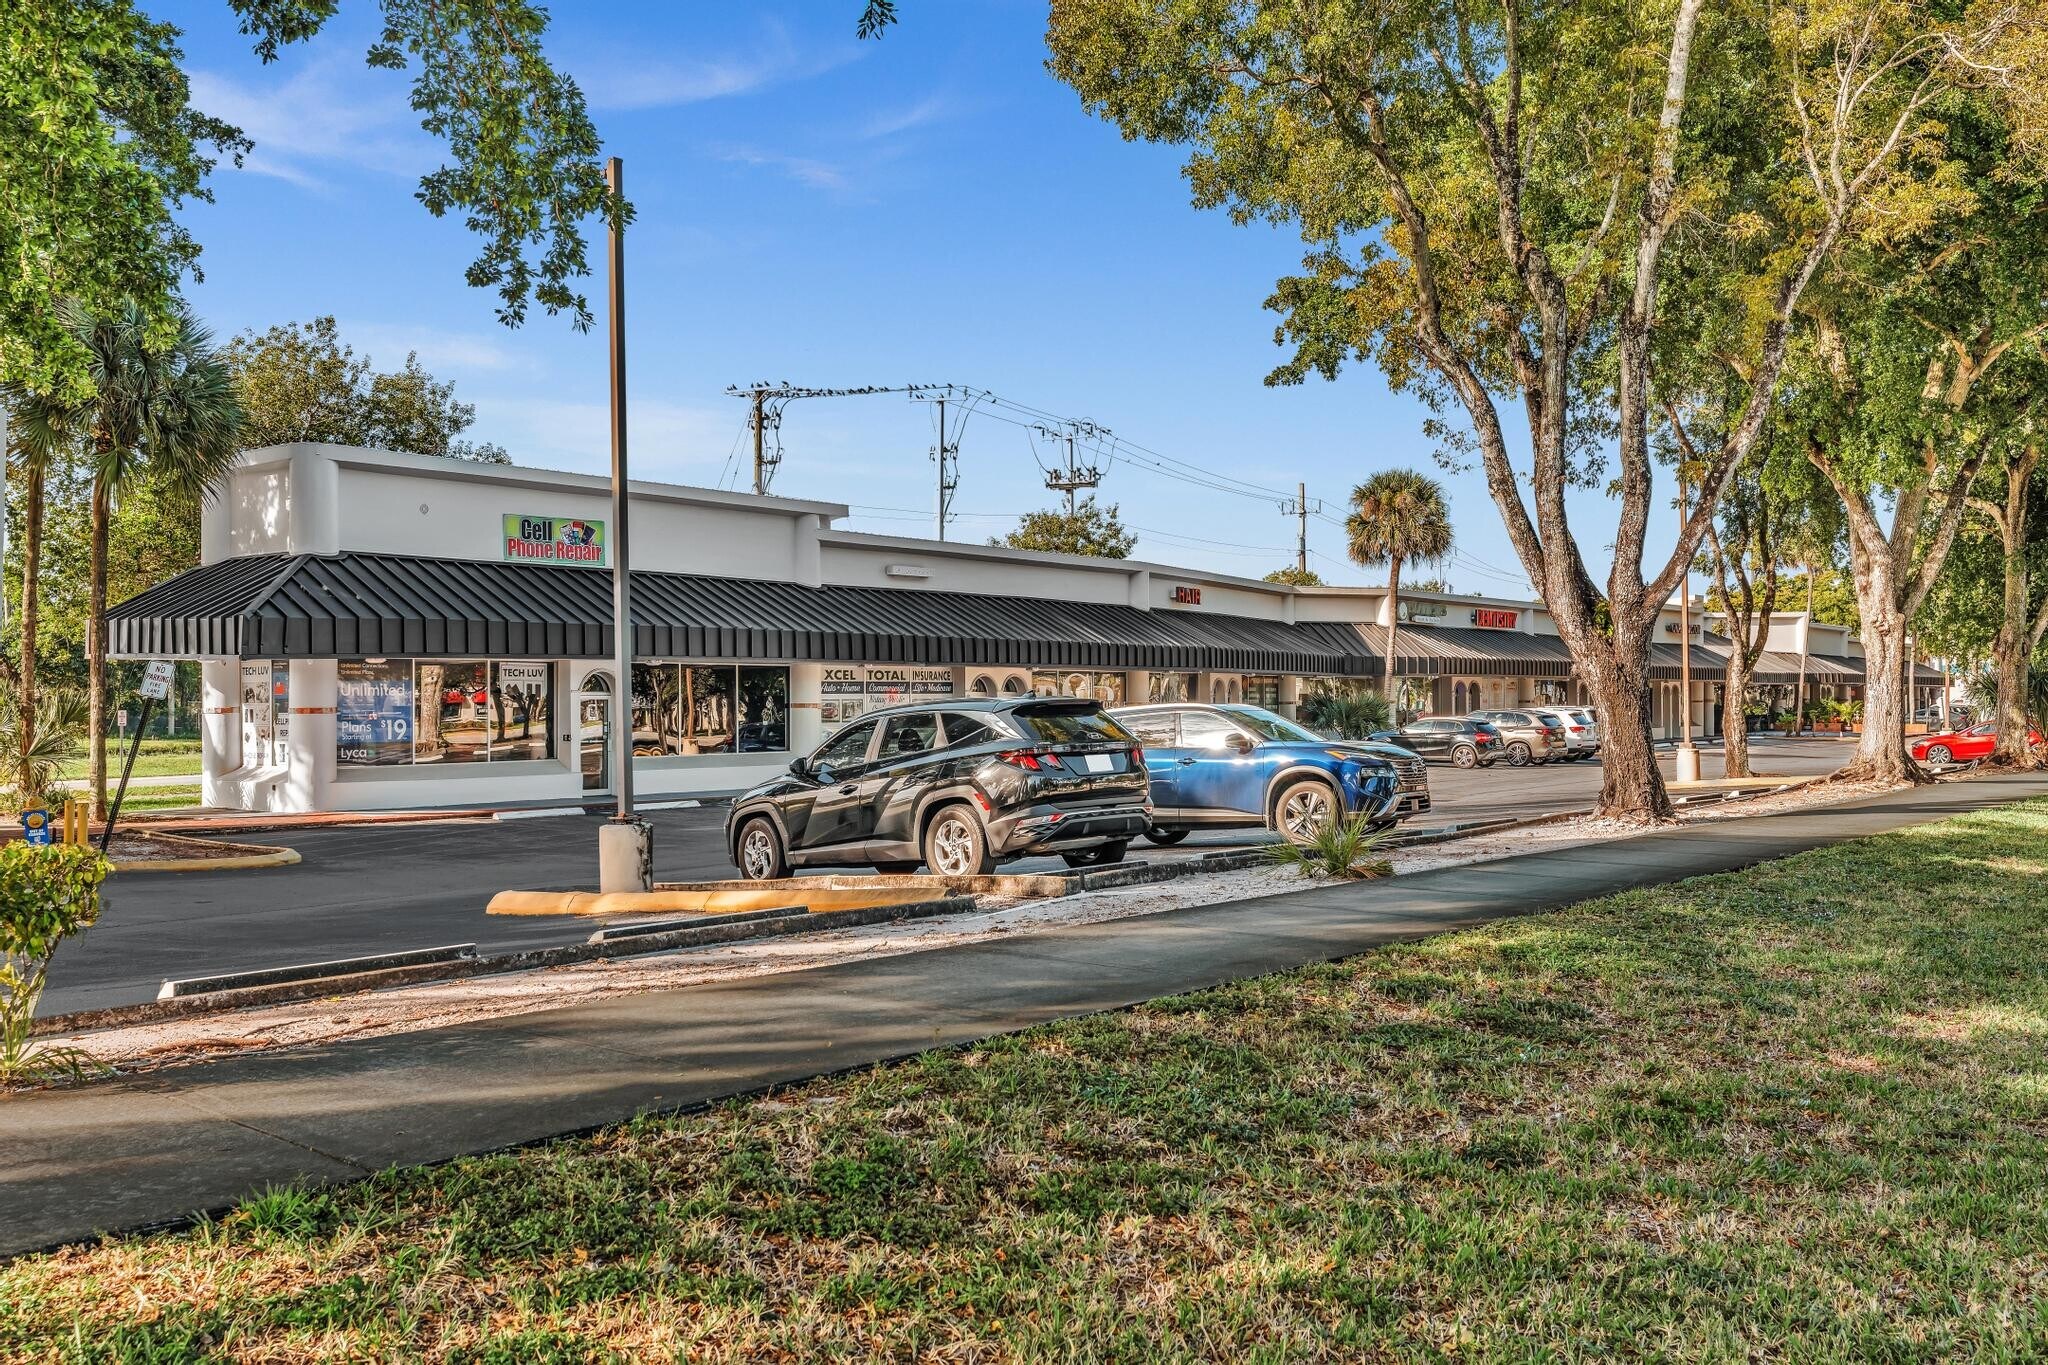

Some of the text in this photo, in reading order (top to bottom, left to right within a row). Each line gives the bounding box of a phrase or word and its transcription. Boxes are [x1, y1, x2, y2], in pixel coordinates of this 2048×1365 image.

[521, 518, 553, 541] Cell
[506, 538, 602, 561] Phone Repair
[1177, 587, 1201, 605] HAIR
[1476, 609, 1519, 629] DENTISTRY
[154, 665, 166, 674] NO
[241, 666, 257, 676] TECH
[257, 665, 270, 675] LUV
[502, 668, 544, 678] TECH LUV
[823, 669, 951, 681] XCEL TOTAL INSURANCE
[145, 672, 170, 684] PARKING
[340, 682, 406, 697] Unlimited
[341, 719, 407, 740] Plans $19
[341, 748, 367, 760] Lyca
